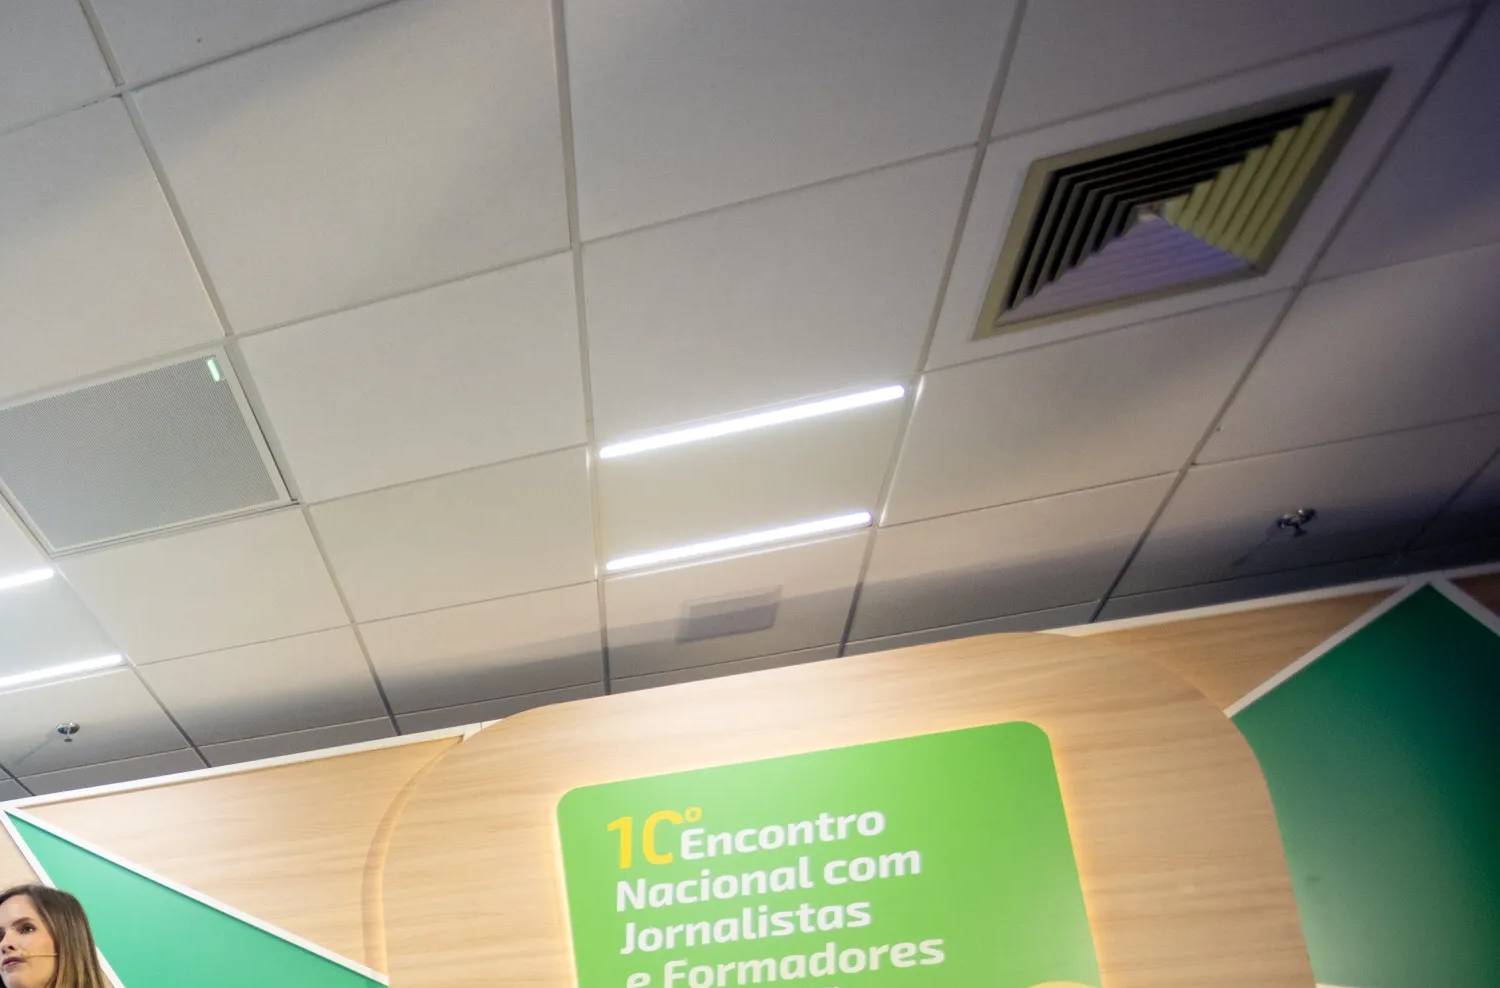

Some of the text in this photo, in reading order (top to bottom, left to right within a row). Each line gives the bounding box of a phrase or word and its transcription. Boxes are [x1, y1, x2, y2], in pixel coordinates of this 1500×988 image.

[680, 811, 885, 860] Encontro
[616, 850, 921, 912] Nacional com
[620, 901, 872, 955] Jornalistas
